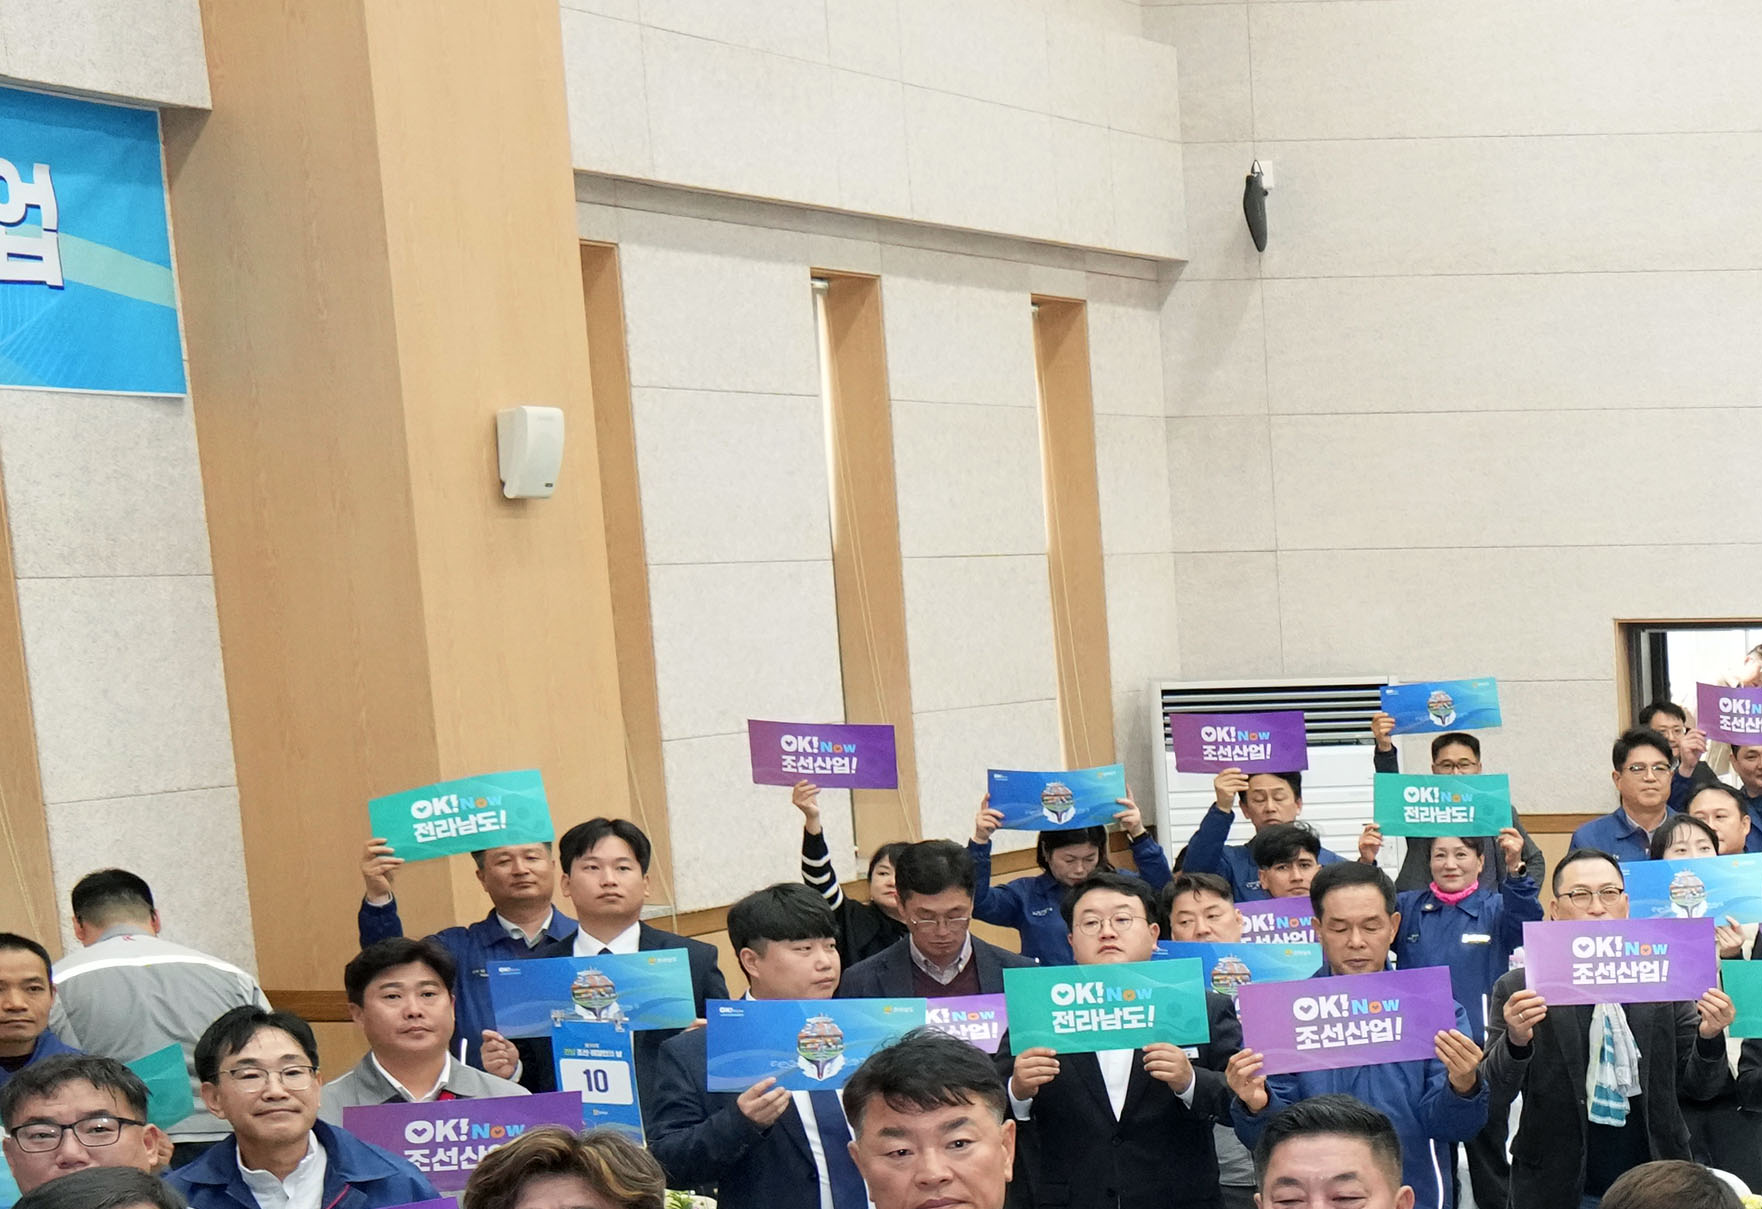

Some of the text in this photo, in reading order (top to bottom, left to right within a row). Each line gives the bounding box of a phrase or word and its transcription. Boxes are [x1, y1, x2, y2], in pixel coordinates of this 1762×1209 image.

[1719, 697, 1750, 714] OK!
[780, 735, 819, 754] OK!
[1201, 726, 1237, 743] OK!
[1203, 742, 1271, 761] 조선산업!
[782, 755, 858, 775] 조선산업!
[1403, 786, 1440, 803] OK!
[411, 795, 459, 819] OK!
[1403, 806, 1475, 824] 전라남도!
[412, 810, 506, 842] 전라남도!
[1572, 936, 1622, 958] OK!
[1572, 961, 1669, 984] 조선산업!
[1051, 982, 1104, 1005] OK!
[1052, 1005, 1155, 1033] 전라남도!
[1293, 995, 1348, 1021] OK!
[1296, 1017, 1402, 1051] 조선산업!
[583, 1068, 608, 1093] 10
[404, 1119, 469, 1143] OK!
